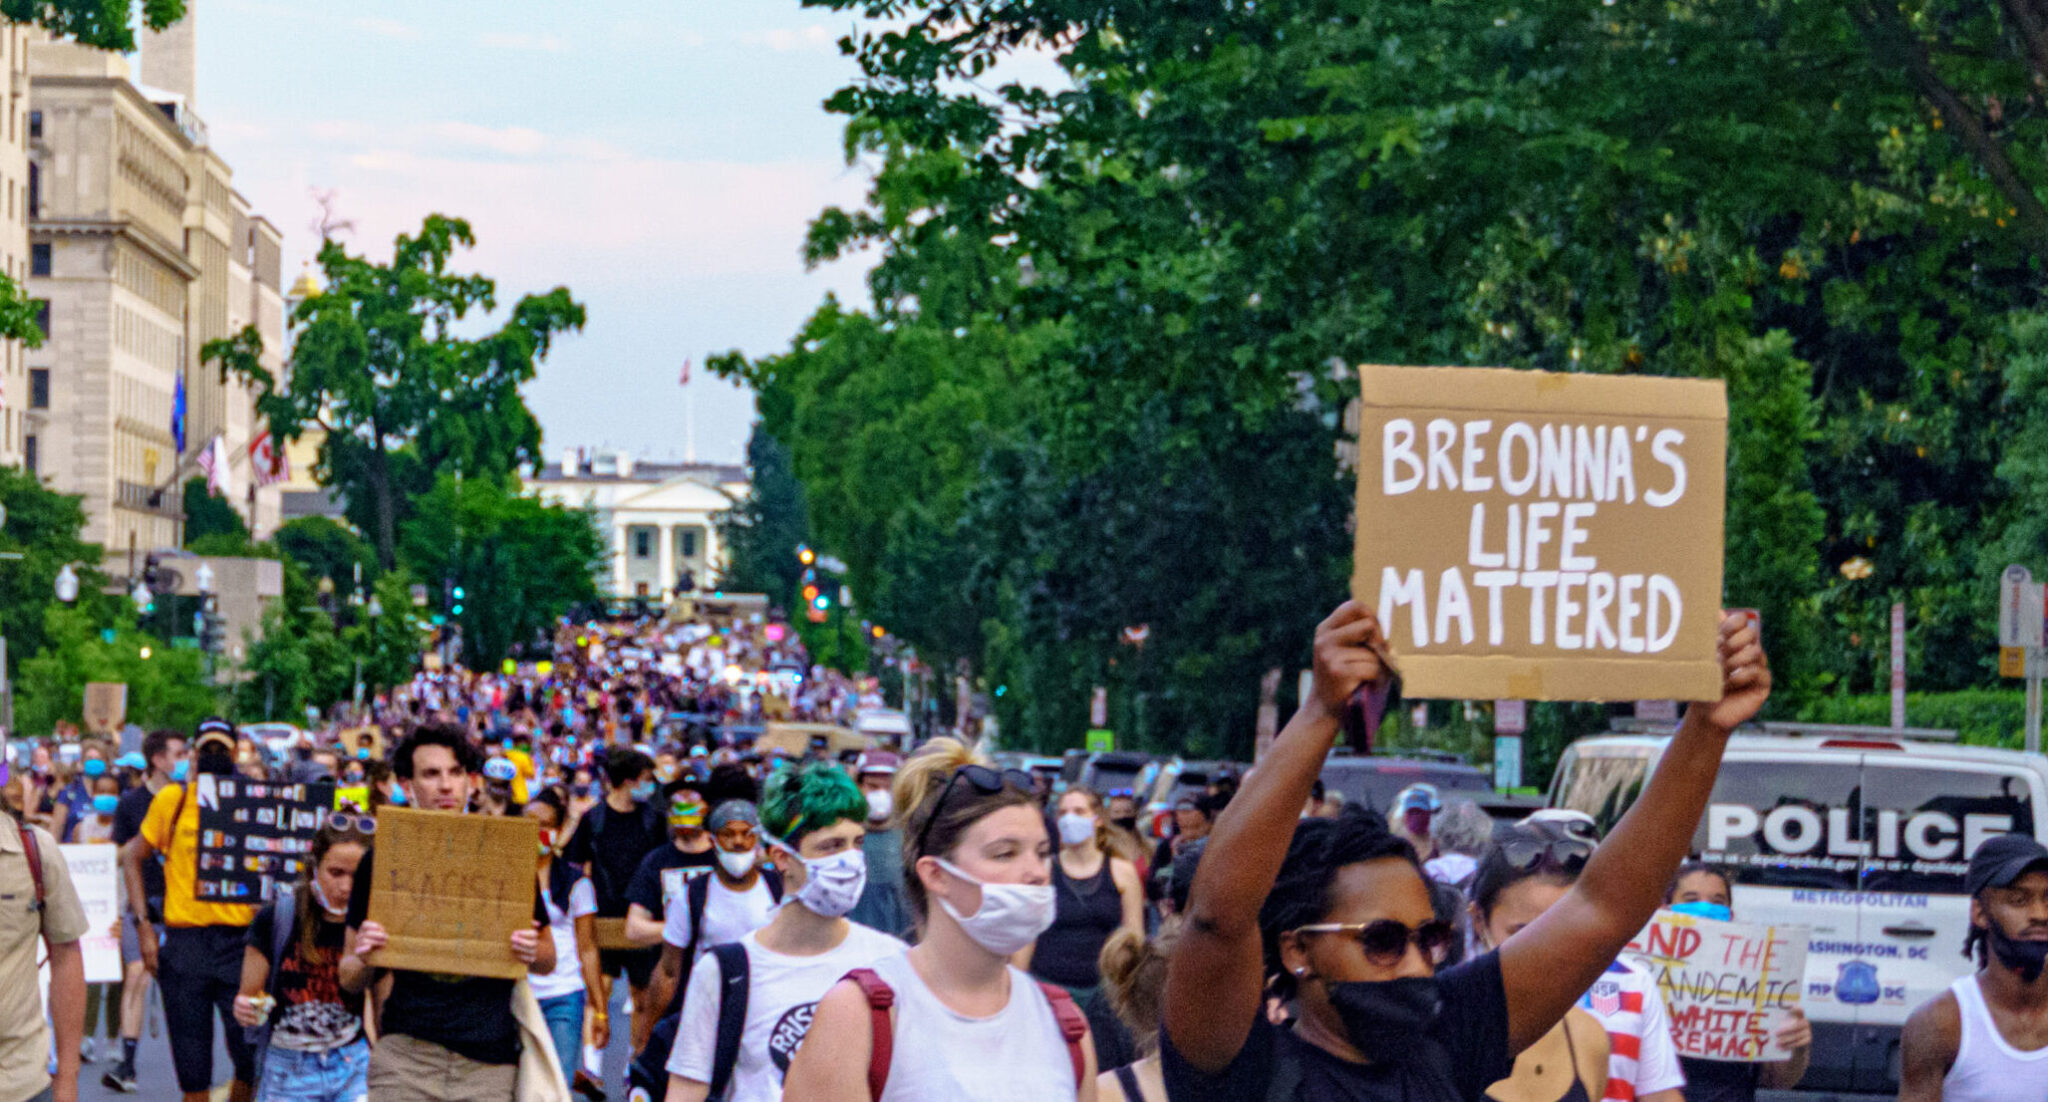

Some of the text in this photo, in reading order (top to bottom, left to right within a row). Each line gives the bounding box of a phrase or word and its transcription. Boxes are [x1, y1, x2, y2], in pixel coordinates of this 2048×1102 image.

[1382, 418, 1687, 507] BREONNA'S
[1469, 502, 1597, 571] LIFE
[1377, 566, 1682, 653] MATTERED
[1708, 803, 2012, 862] POLICE
[1791, 888, 1928, 908] METROPOLITAN
[1624, 923, 1788, 973] ND THE
[1907, 945, 1929, 960] DC
[1884, 986, 1905, 999] DC
[771, 1004, 817, 1053] RAIS
[1668, 1002, 1769, 1035] WHITE
